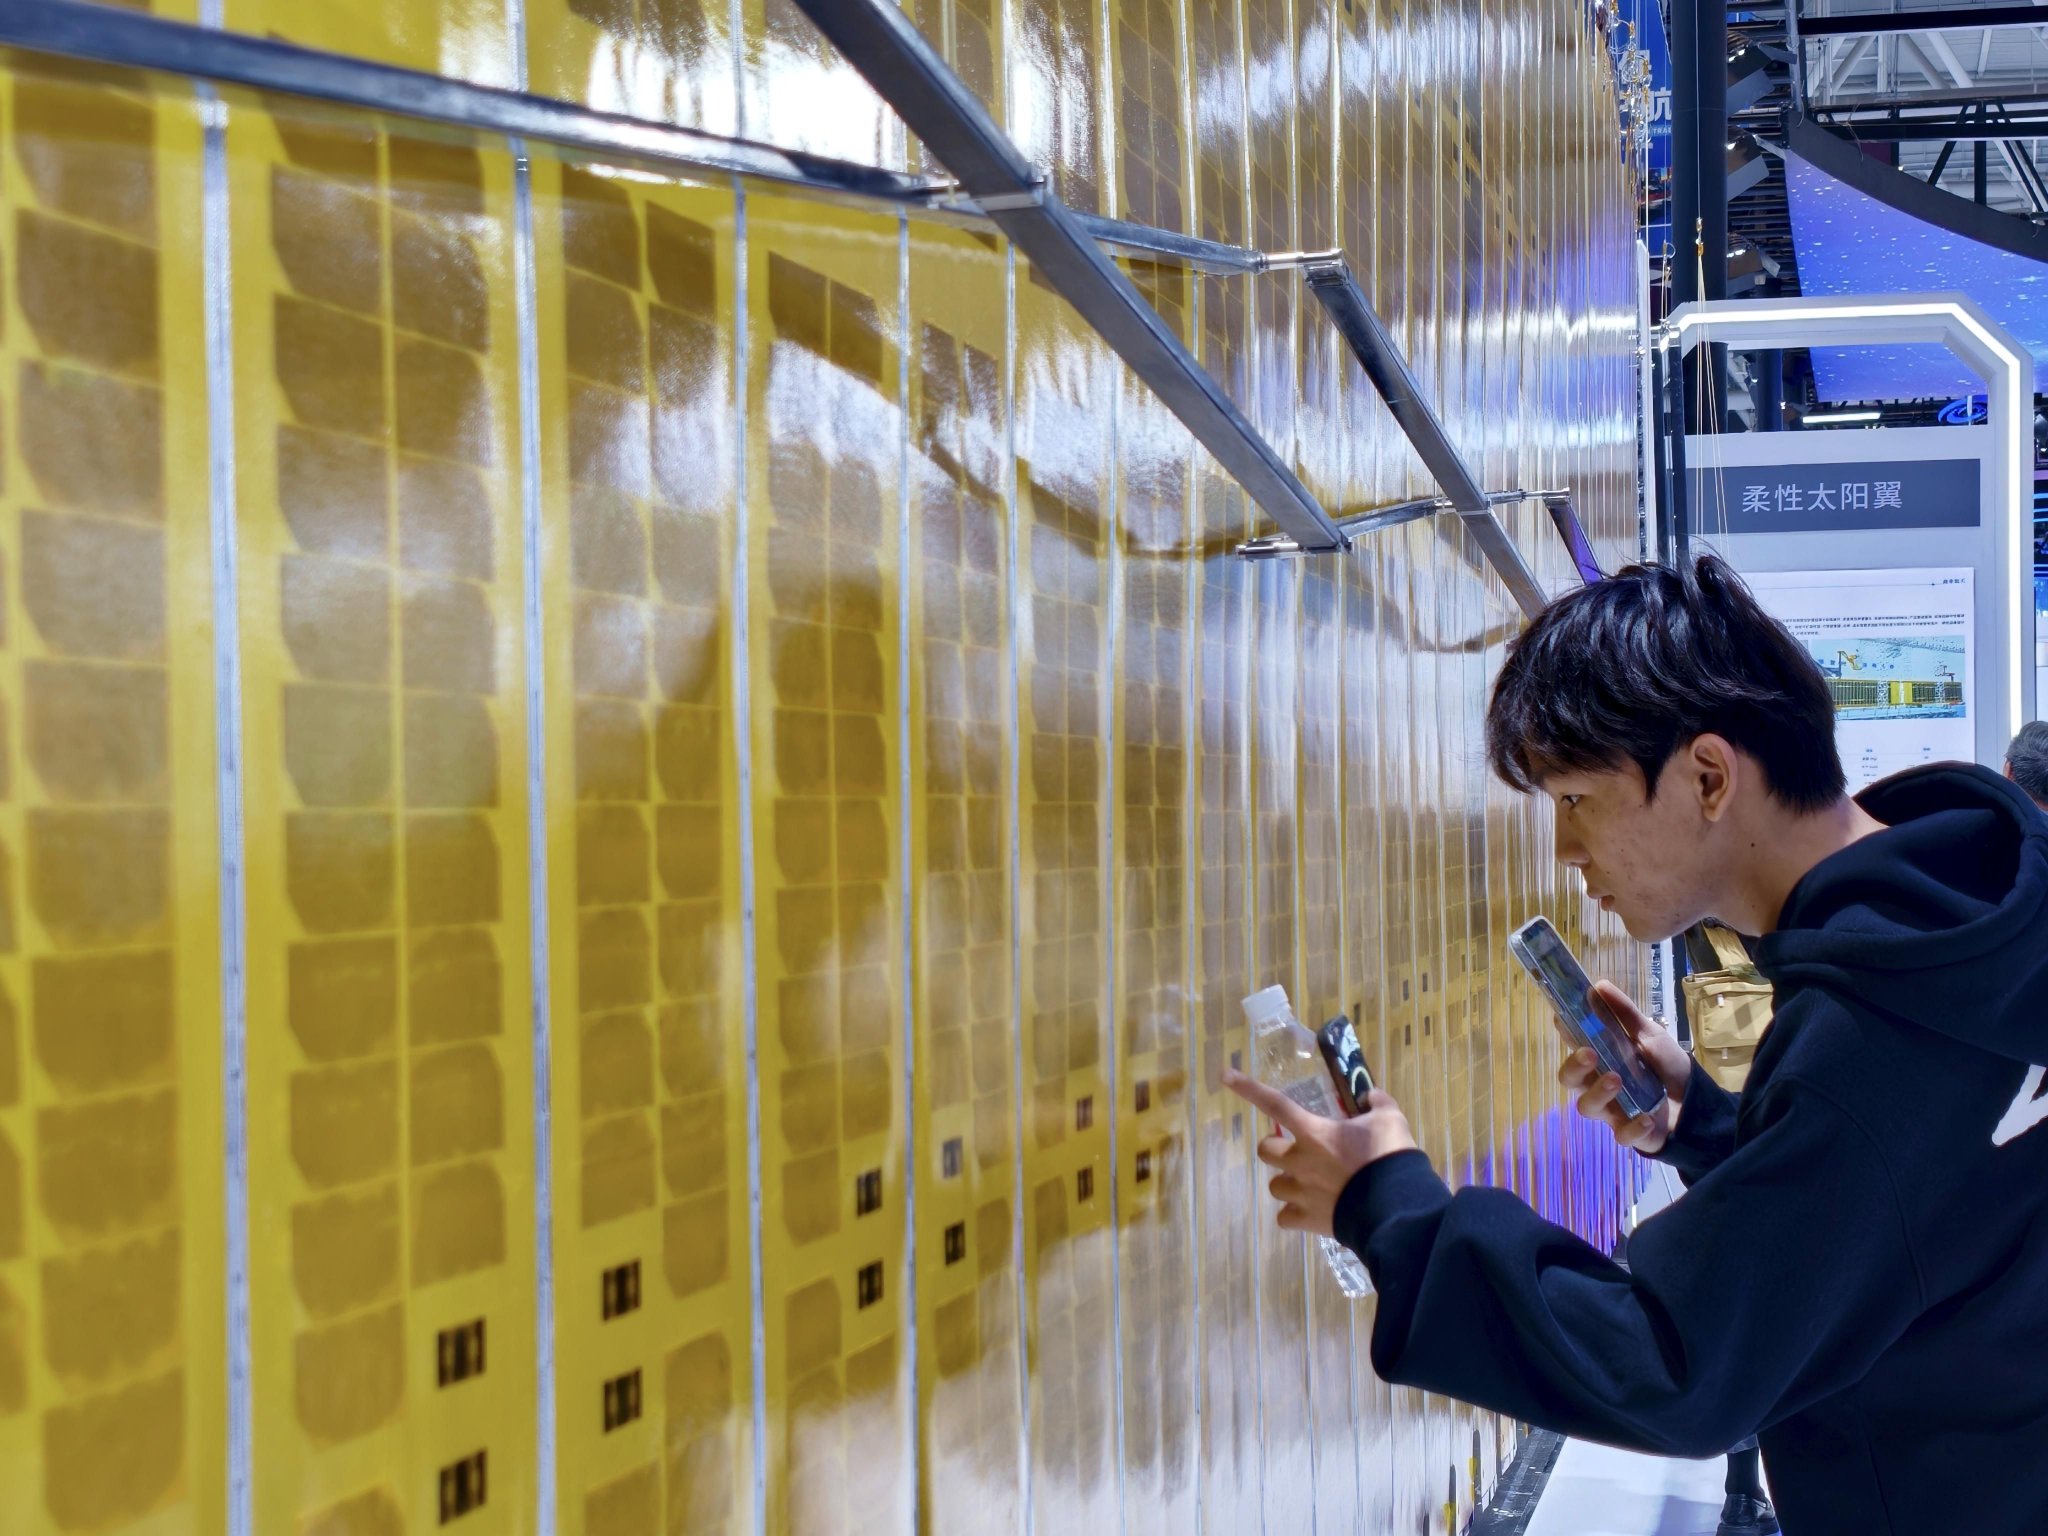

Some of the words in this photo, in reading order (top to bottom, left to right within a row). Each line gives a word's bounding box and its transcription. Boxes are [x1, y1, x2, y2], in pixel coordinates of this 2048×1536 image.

[1742, 481, 1903, 513] 柔性太阳翼
